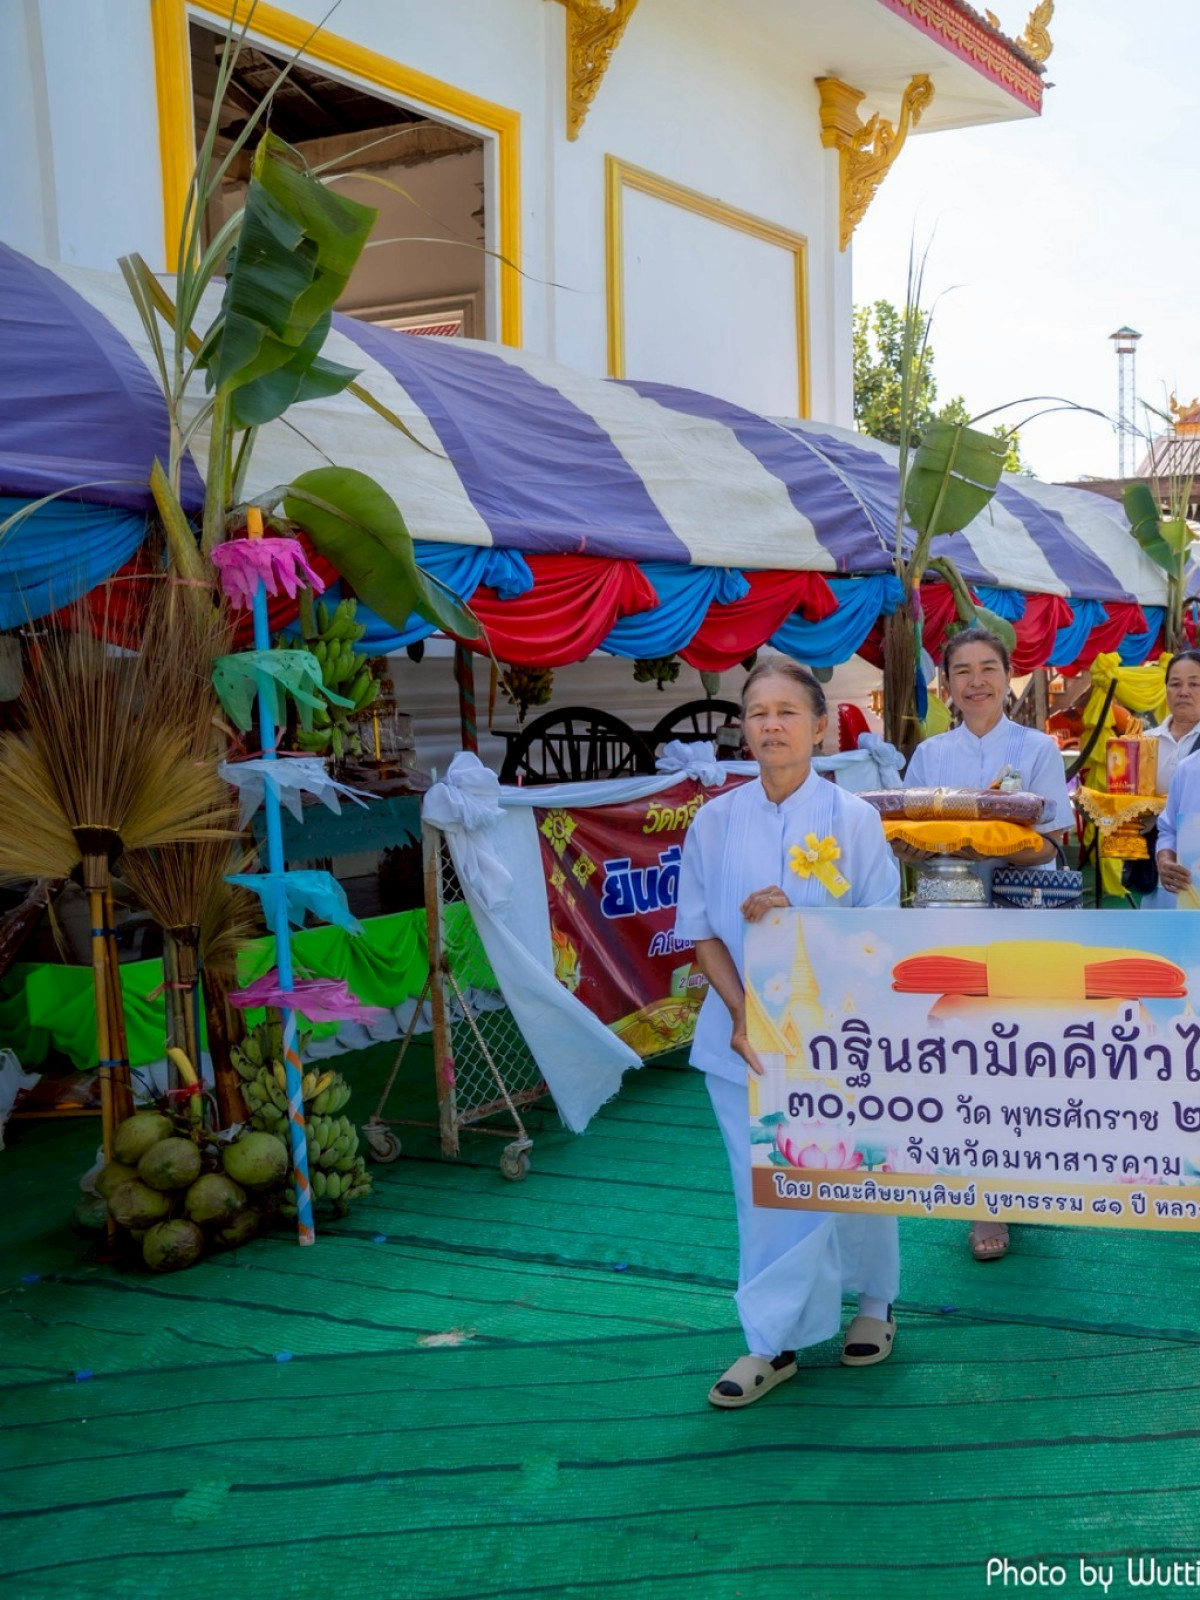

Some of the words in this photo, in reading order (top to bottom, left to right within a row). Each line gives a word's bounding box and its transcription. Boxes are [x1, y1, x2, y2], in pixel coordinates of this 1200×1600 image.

[788, 1089, 943, 1126] ๓๐,๐๐๐
[956, 1094, 991, 1125] วัด
[1000, 1097, 1159, 1138] พุทธศักราช
[906, 1137, 1180, 1176] จังหวัดมหาสารคาม
[774, 1175, 811, 1198] โดย
[818, 1181, 975, 1212] คณะศิษยานุศิษย์
[984, 1190, 1083, 1215] บูชาธรรม
[1092, 1198, 1122, 1215] ๘๑
[1131, 1193, 1147, 1215] ปี
